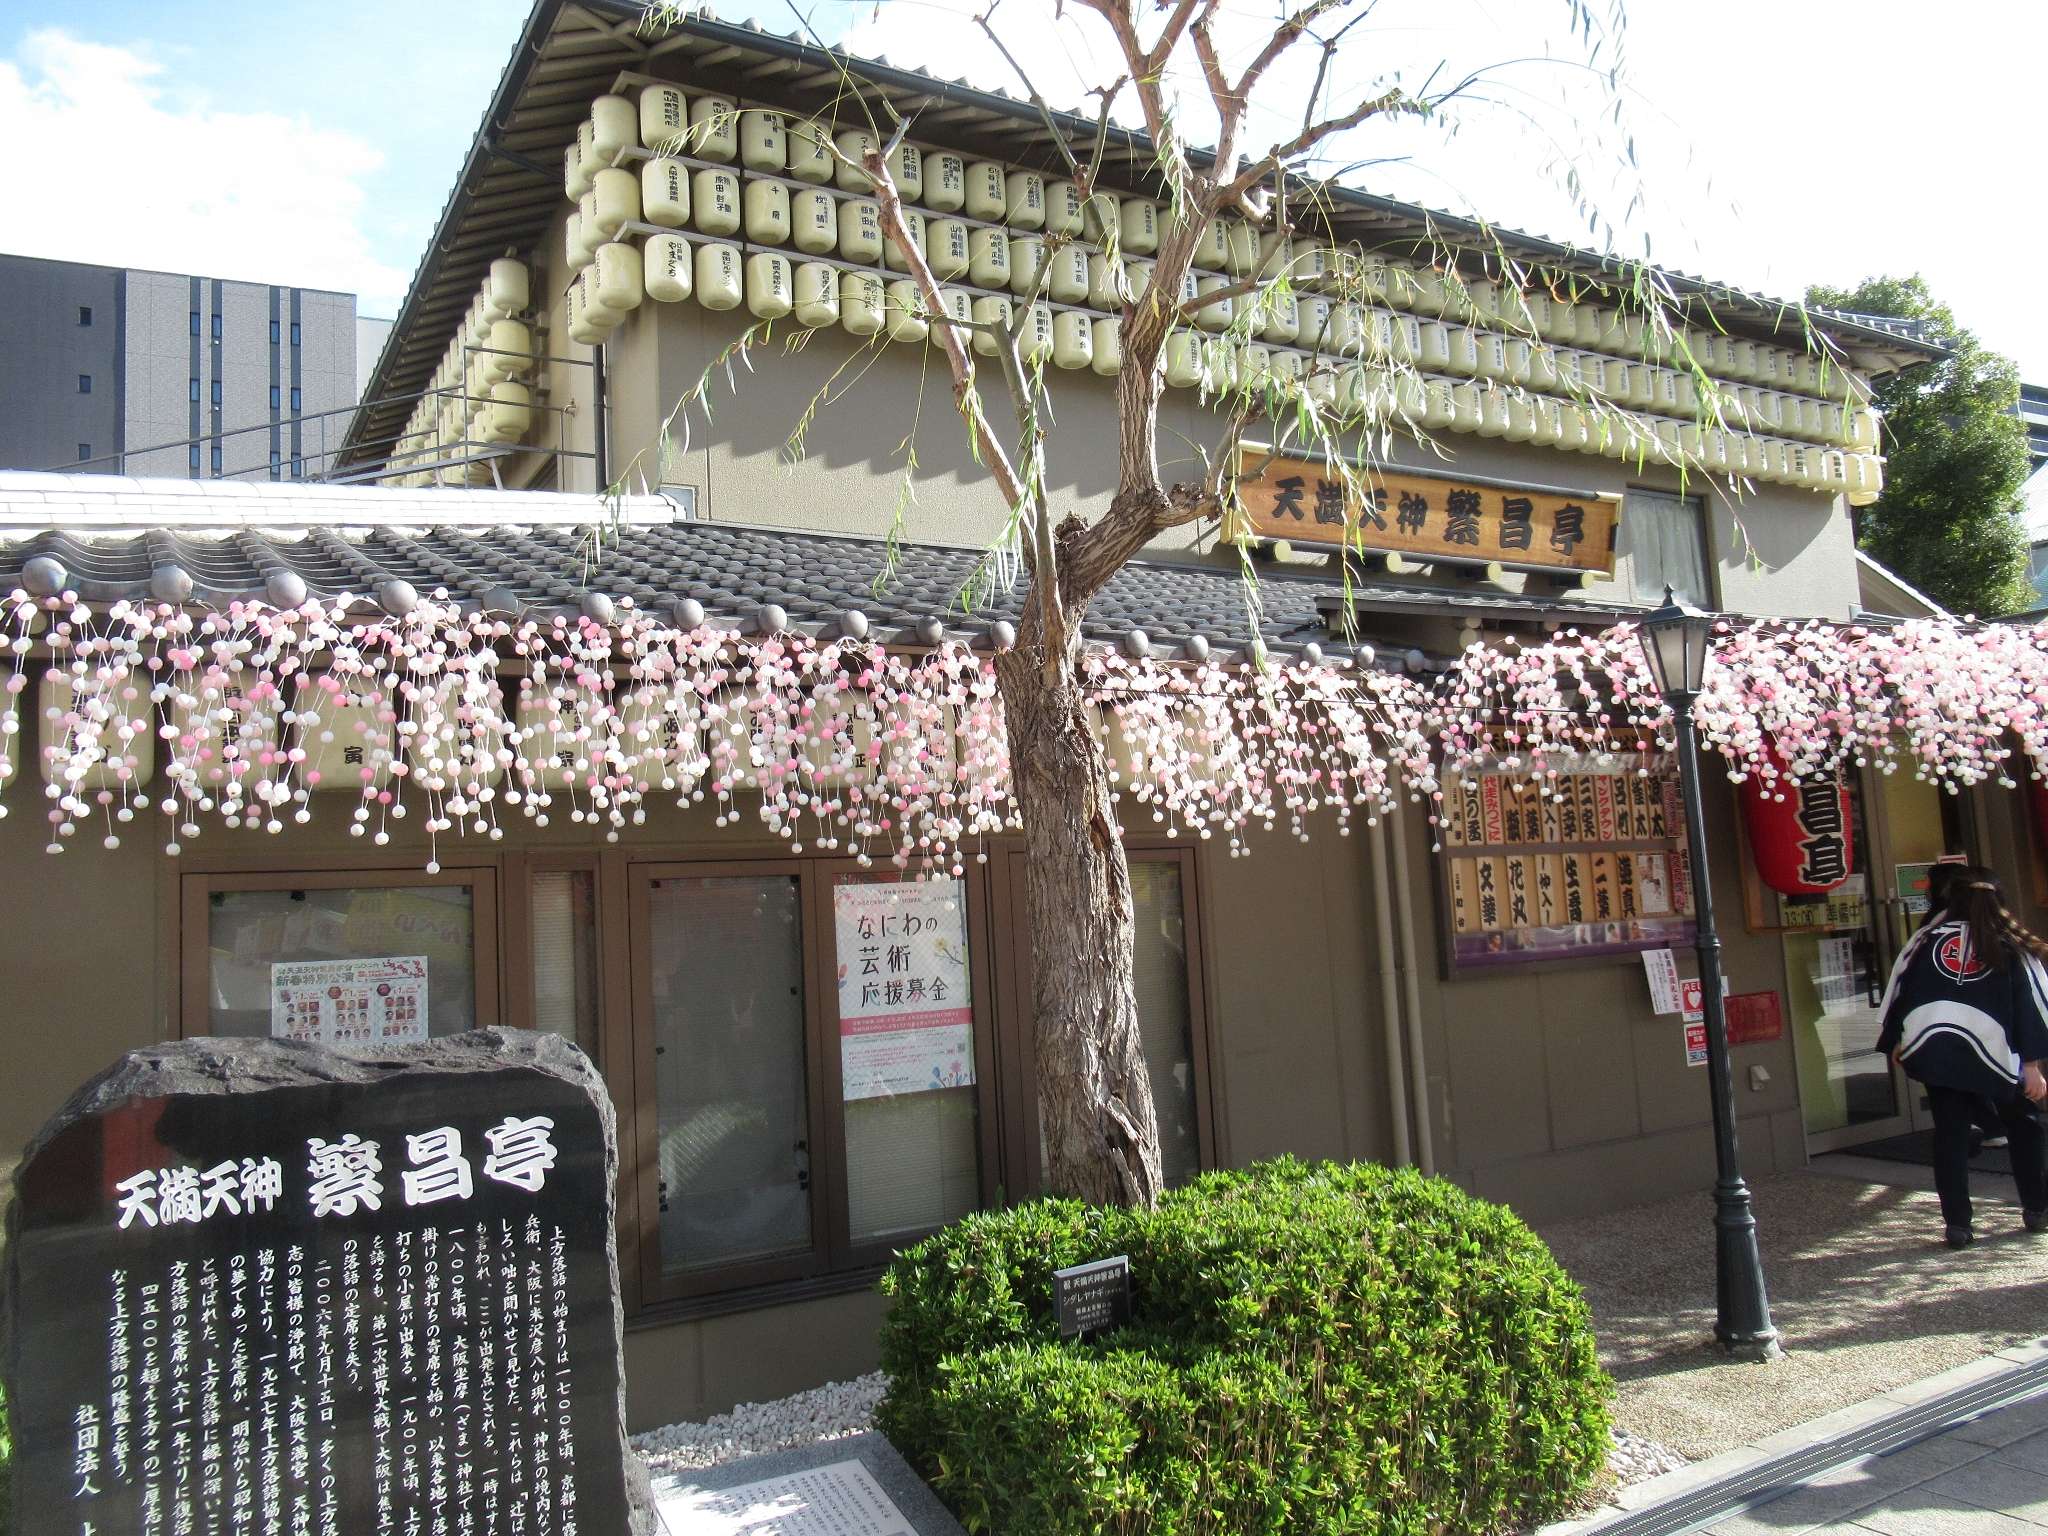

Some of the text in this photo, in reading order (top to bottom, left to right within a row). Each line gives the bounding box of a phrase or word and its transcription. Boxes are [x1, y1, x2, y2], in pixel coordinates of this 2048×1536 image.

[667, 241, 677, 277] やまぐち
[1272, 475, 1585, 557] 天満天神繁昌亭
[856, 912, 938, 940] なにわの
[857, 944, 911, 976] 芸術
[861, 976, 949, 1008] 応援募金
[116, 1115, 558, 1230] 天満天神 繁昌亭
[343, 1239, 363, 1392] の落語の定席を失う。
[73, 1404, 102, 1498] 社団法人
